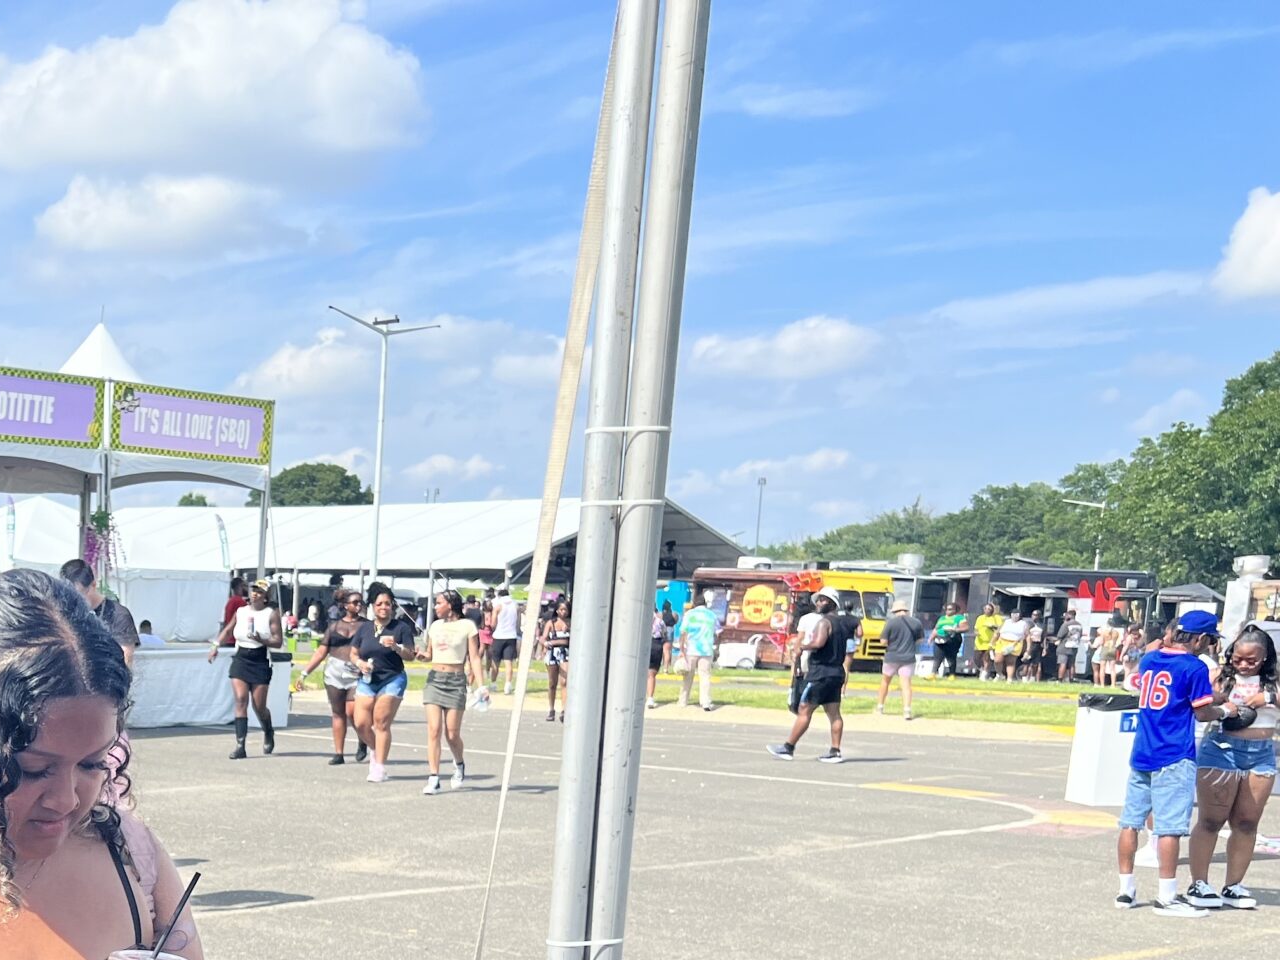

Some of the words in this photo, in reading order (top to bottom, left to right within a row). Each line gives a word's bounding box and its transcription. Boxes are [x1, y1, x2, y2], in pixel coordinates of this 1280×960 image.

[133, 407, 159, 435] IT'S
[161, 413, 183, 437] ALL
[185, 414, 213, 441] LOVE
[215, 418, 251, 450] (SBQ)
[1139, 670, 1172, 710] 16
